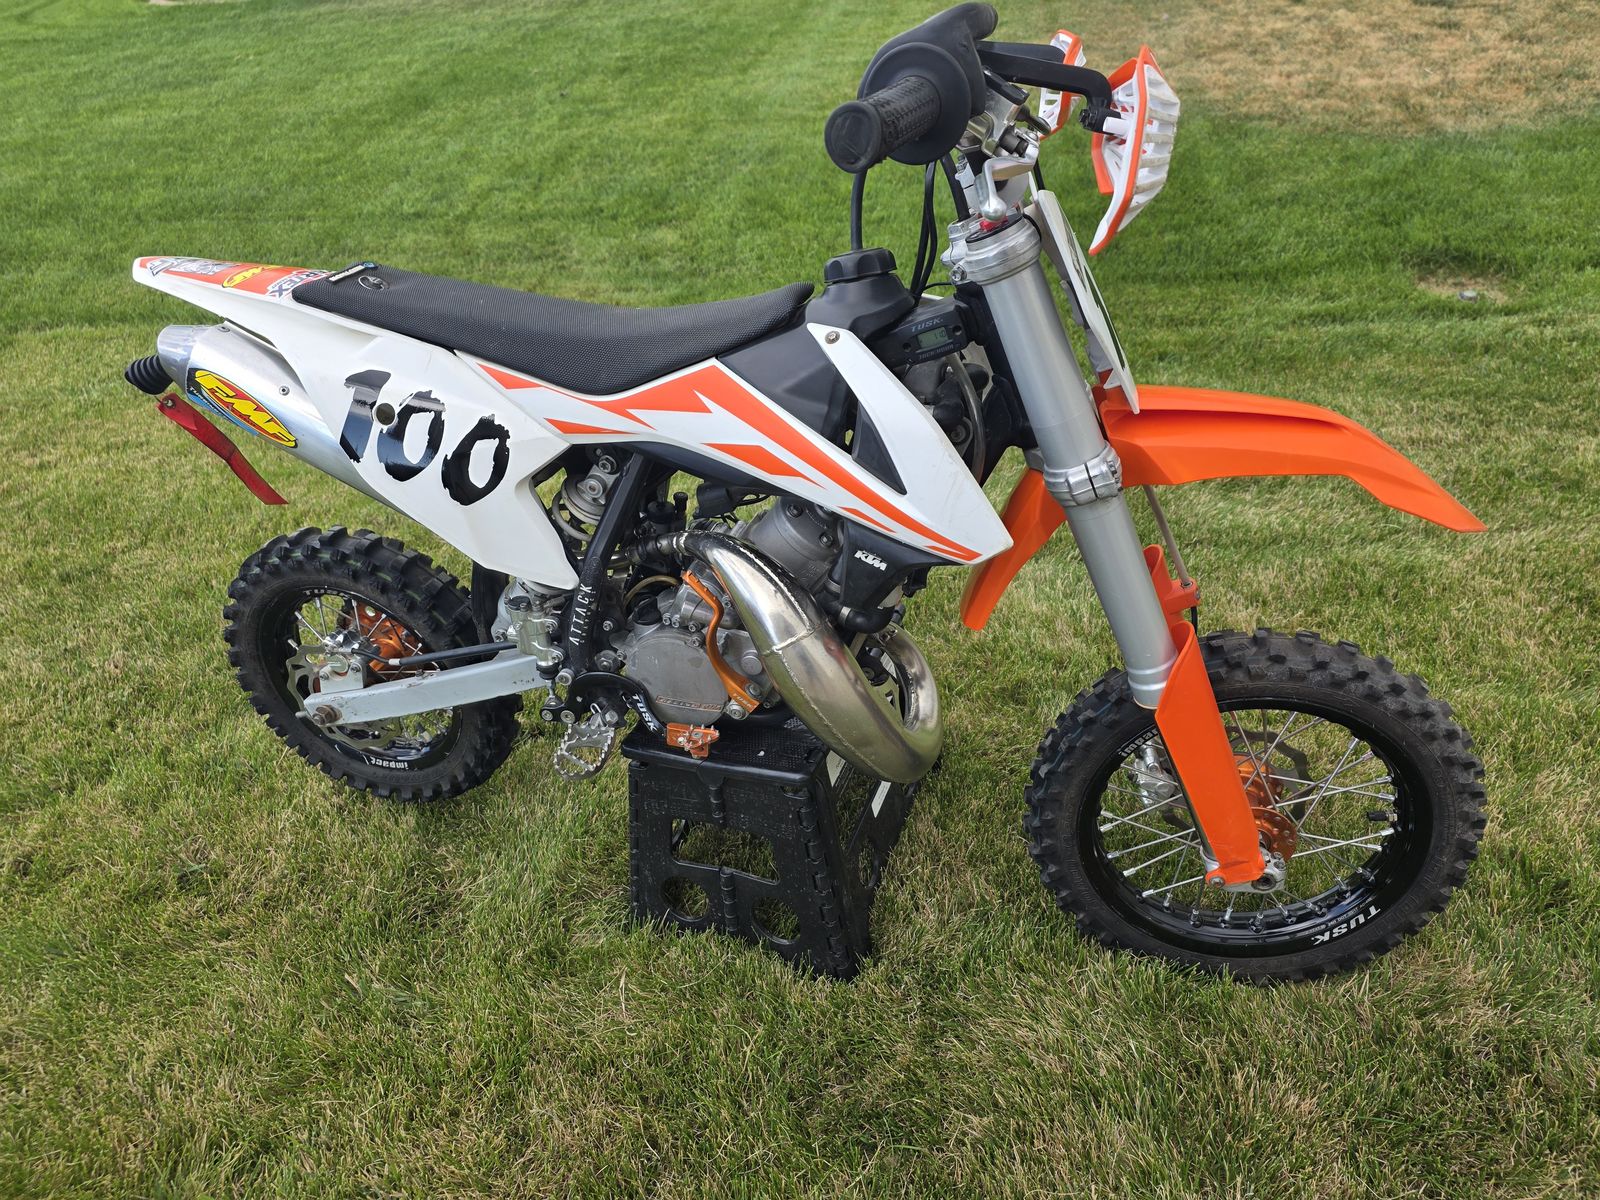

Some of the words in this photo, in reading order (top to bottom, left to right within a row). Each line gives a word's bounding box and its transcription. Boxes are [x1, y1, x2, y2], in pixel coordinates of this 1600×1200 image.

[912, 317, 941, 332] TUSK
[194, 373, 297, 443] FMF
[339, 369, 510, 506] 100
[854, 549, 888, 571] KTM
[568, 583, 593, 646] ATTACK
[632, 693, 658, 733] TUSK
[369, 755, 409, 770] impact
[1311, 904, 1381, 946] TUSK
